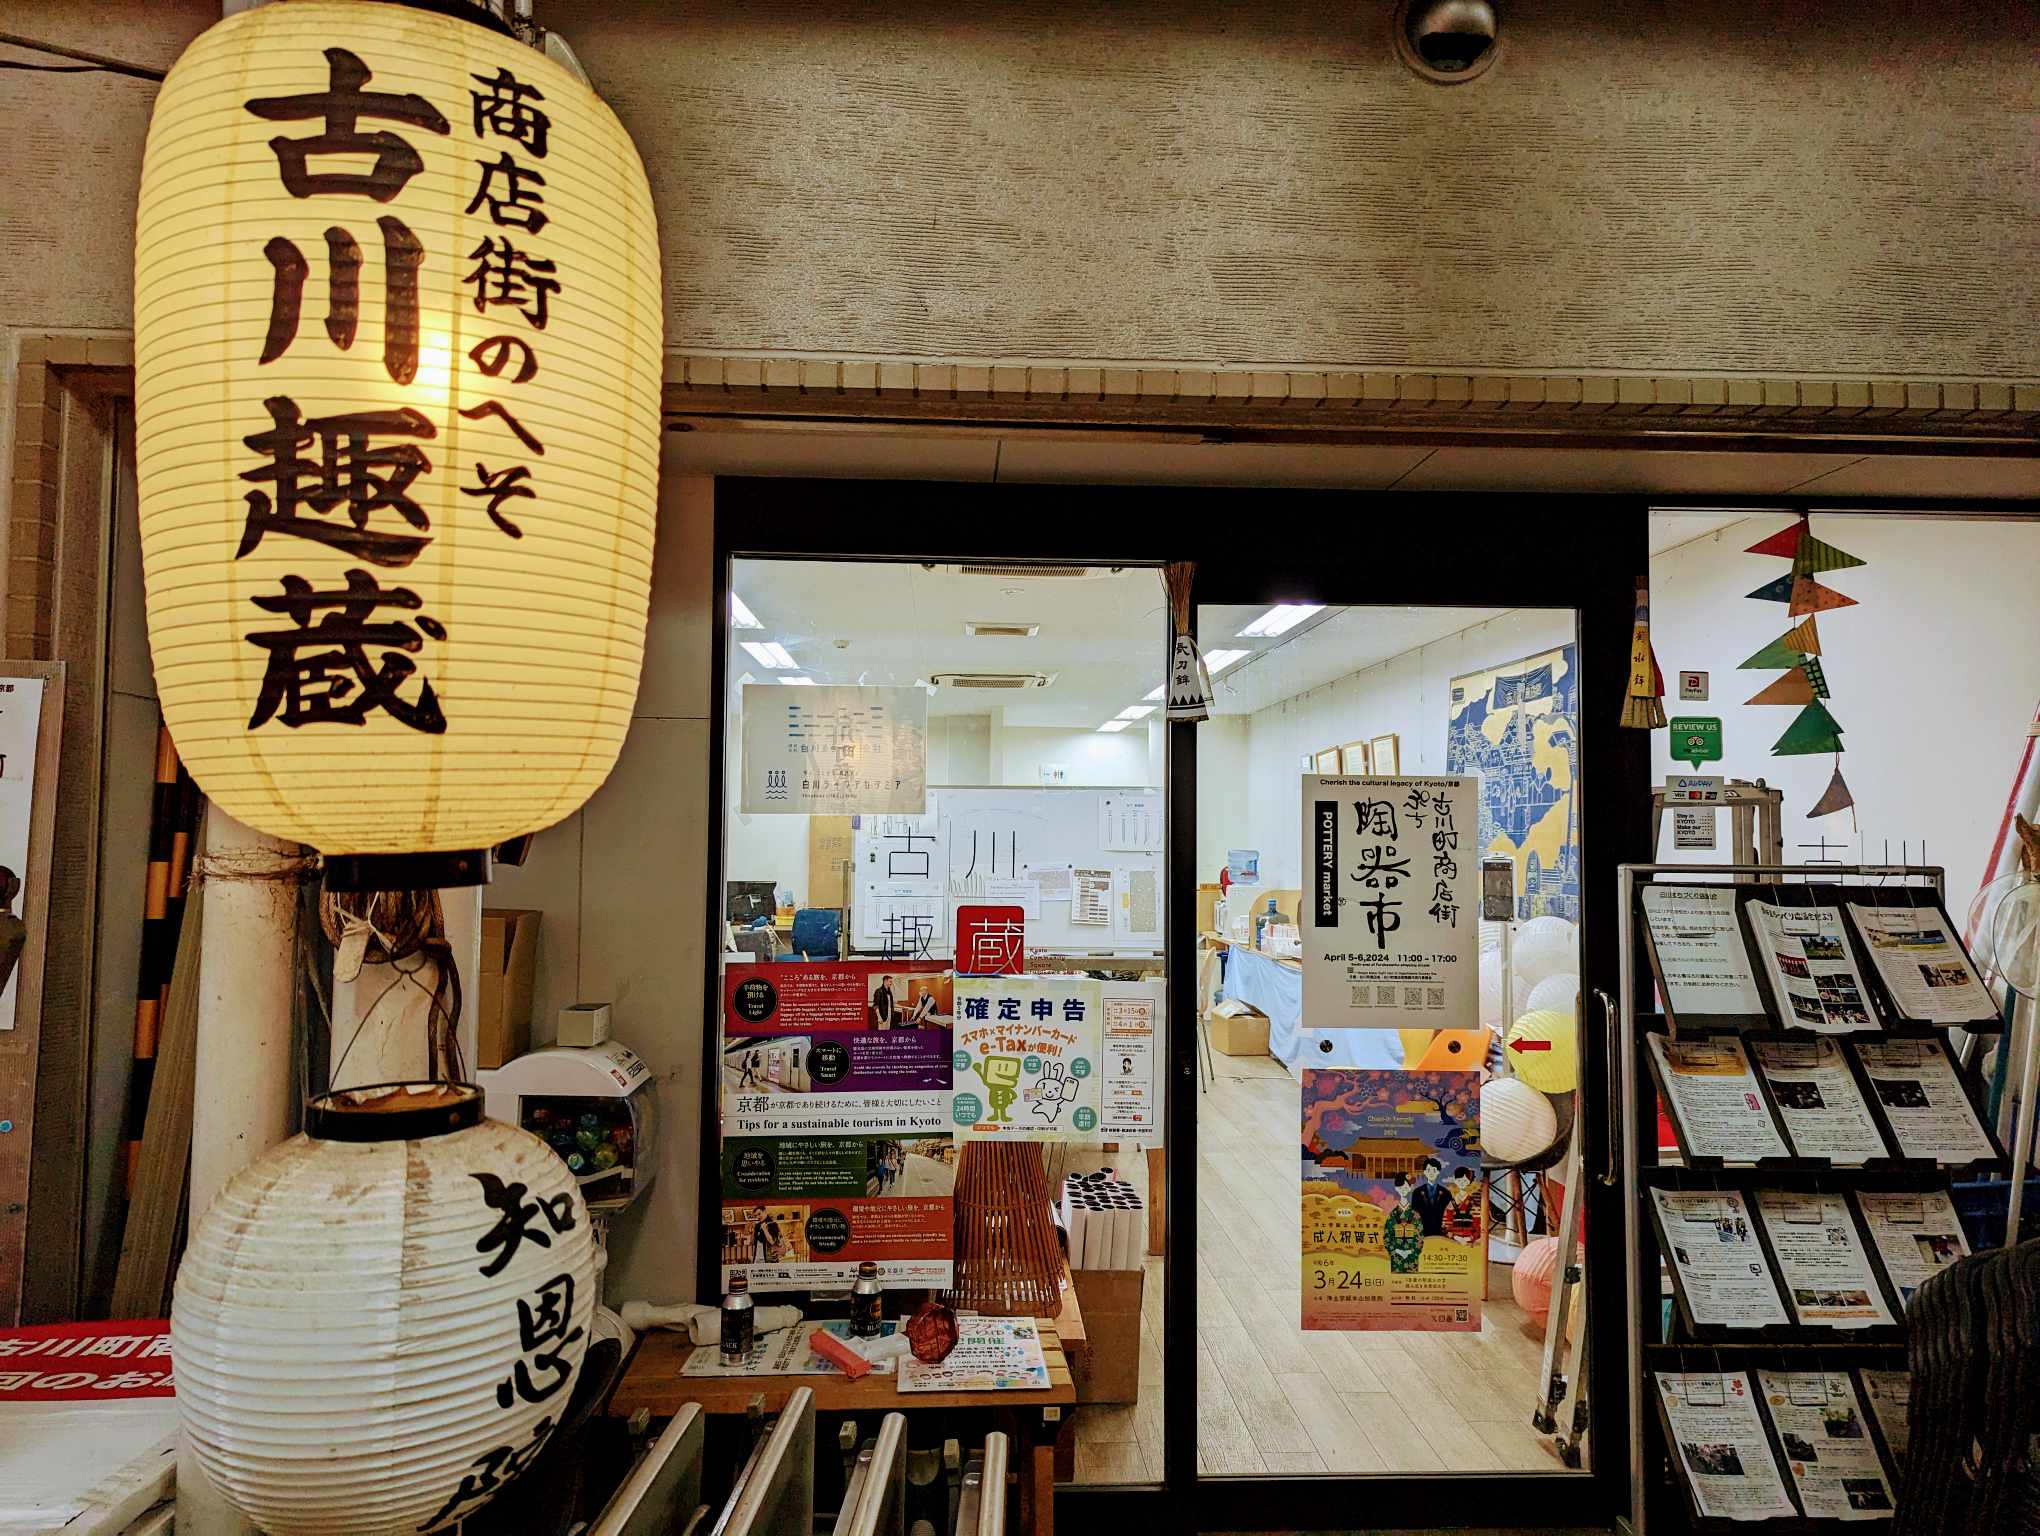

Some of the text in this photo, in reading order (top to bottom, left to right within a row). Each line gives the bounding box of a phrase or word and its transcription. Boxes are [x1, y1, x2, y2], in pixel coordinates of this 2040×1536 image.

[460, 67, 562, 539] 商店街のへそ
[237, 47, 451, 735] 古川趣蔵
[1176, 642, 1190, 686] 長刀鉾
[1672, 723, 1705, 731] REVIEW
[1390, 780, 1412, 788] legacy
[883, 826, 1016, 879] 古川
[1323, 811, 1333, 916] POTTERY market
[1350, 796, 1411, 950] 陶器市
[1429, 792, 1460, 929] 古川町商店街
[1324, 954, 1346, 963] April
[1348, 954, 1389, 962] 5-6,2024
[1398, 954, 1422, 962] 11:00
[1431, 955, 1457, 963] 17:00
[965, 997, 1086, 1022] 確定申告
[737, 1119, 761, 1132] Tips
[763, 1118, 778, 1129] for
[791, 1117, 849, 1129] sustainable
[852, 1117, 893, 1128] tourism
[896, 1117, 906, 1127] in
[910, 1116, 941, 1128] Kyoto
[1313, 1230, 1379, 1244] 成人祝賀式
